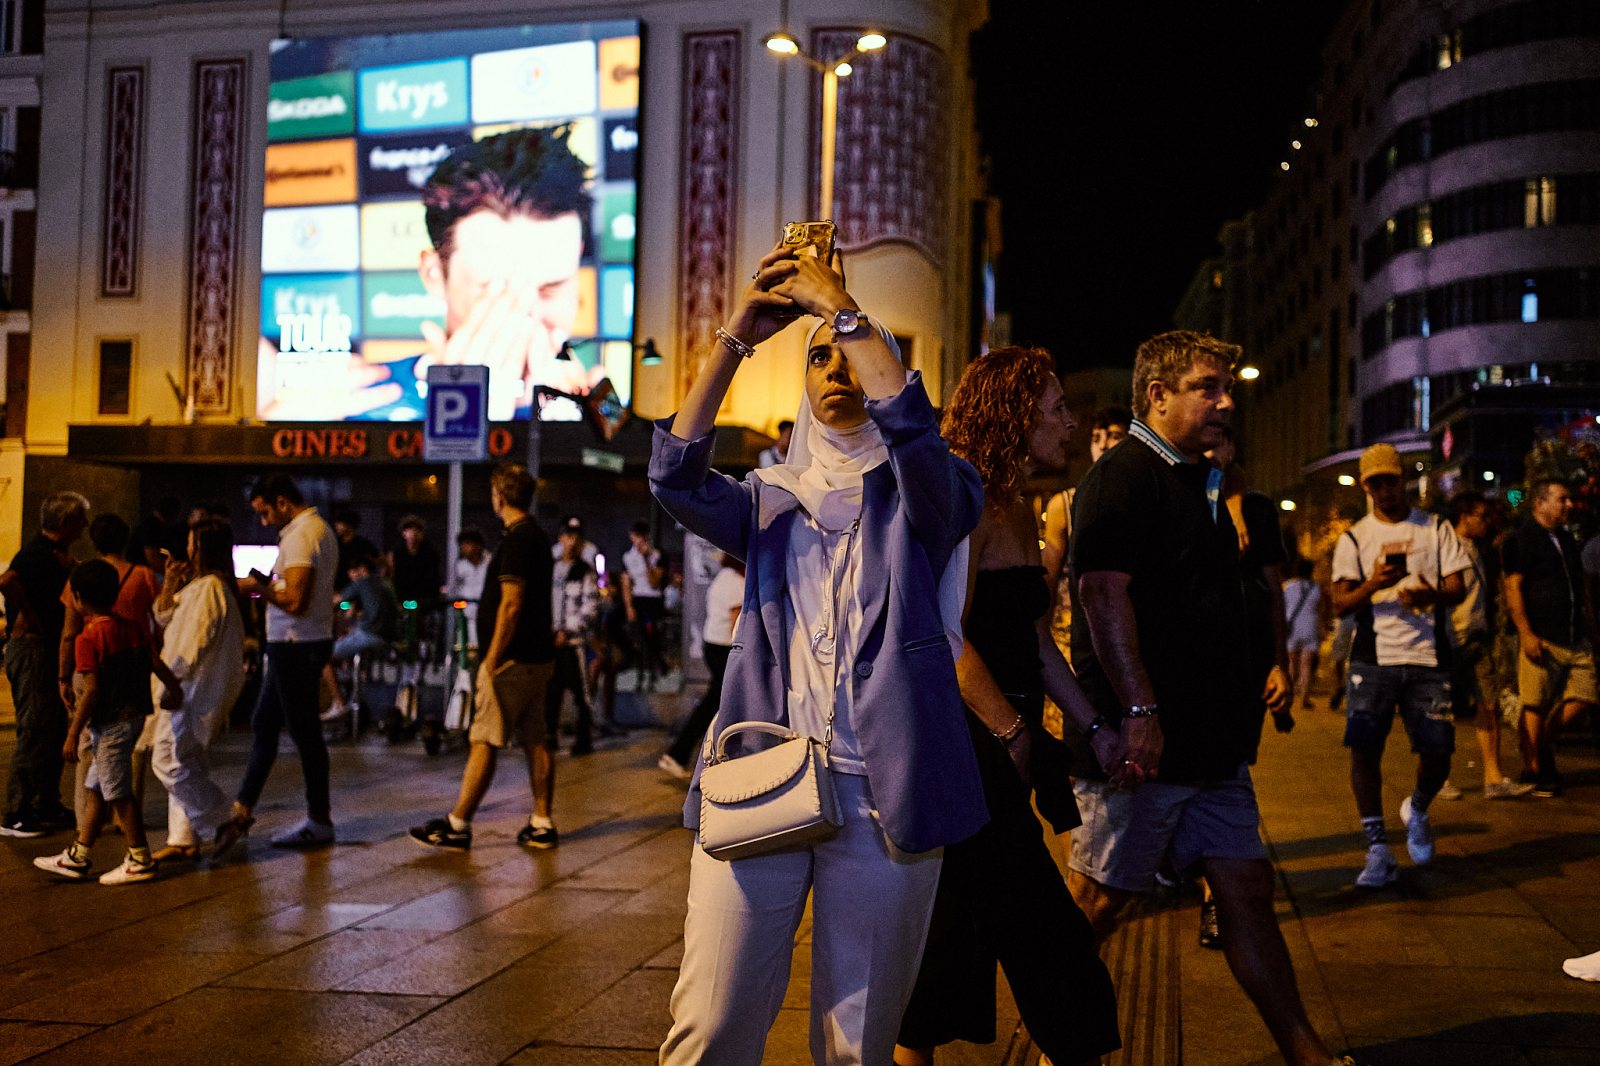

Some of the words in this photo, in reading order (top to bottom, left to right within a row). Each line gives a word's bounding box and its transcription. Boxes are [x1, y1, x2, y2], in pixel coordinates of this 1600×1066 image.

[376, 80, 448, 119] Krys
[276, 313, 352, 352] TOUR
[435, 390, 468, 434] P
[272, 429, 367, 457] CINES
[388, 429, 513, 457] CAO
